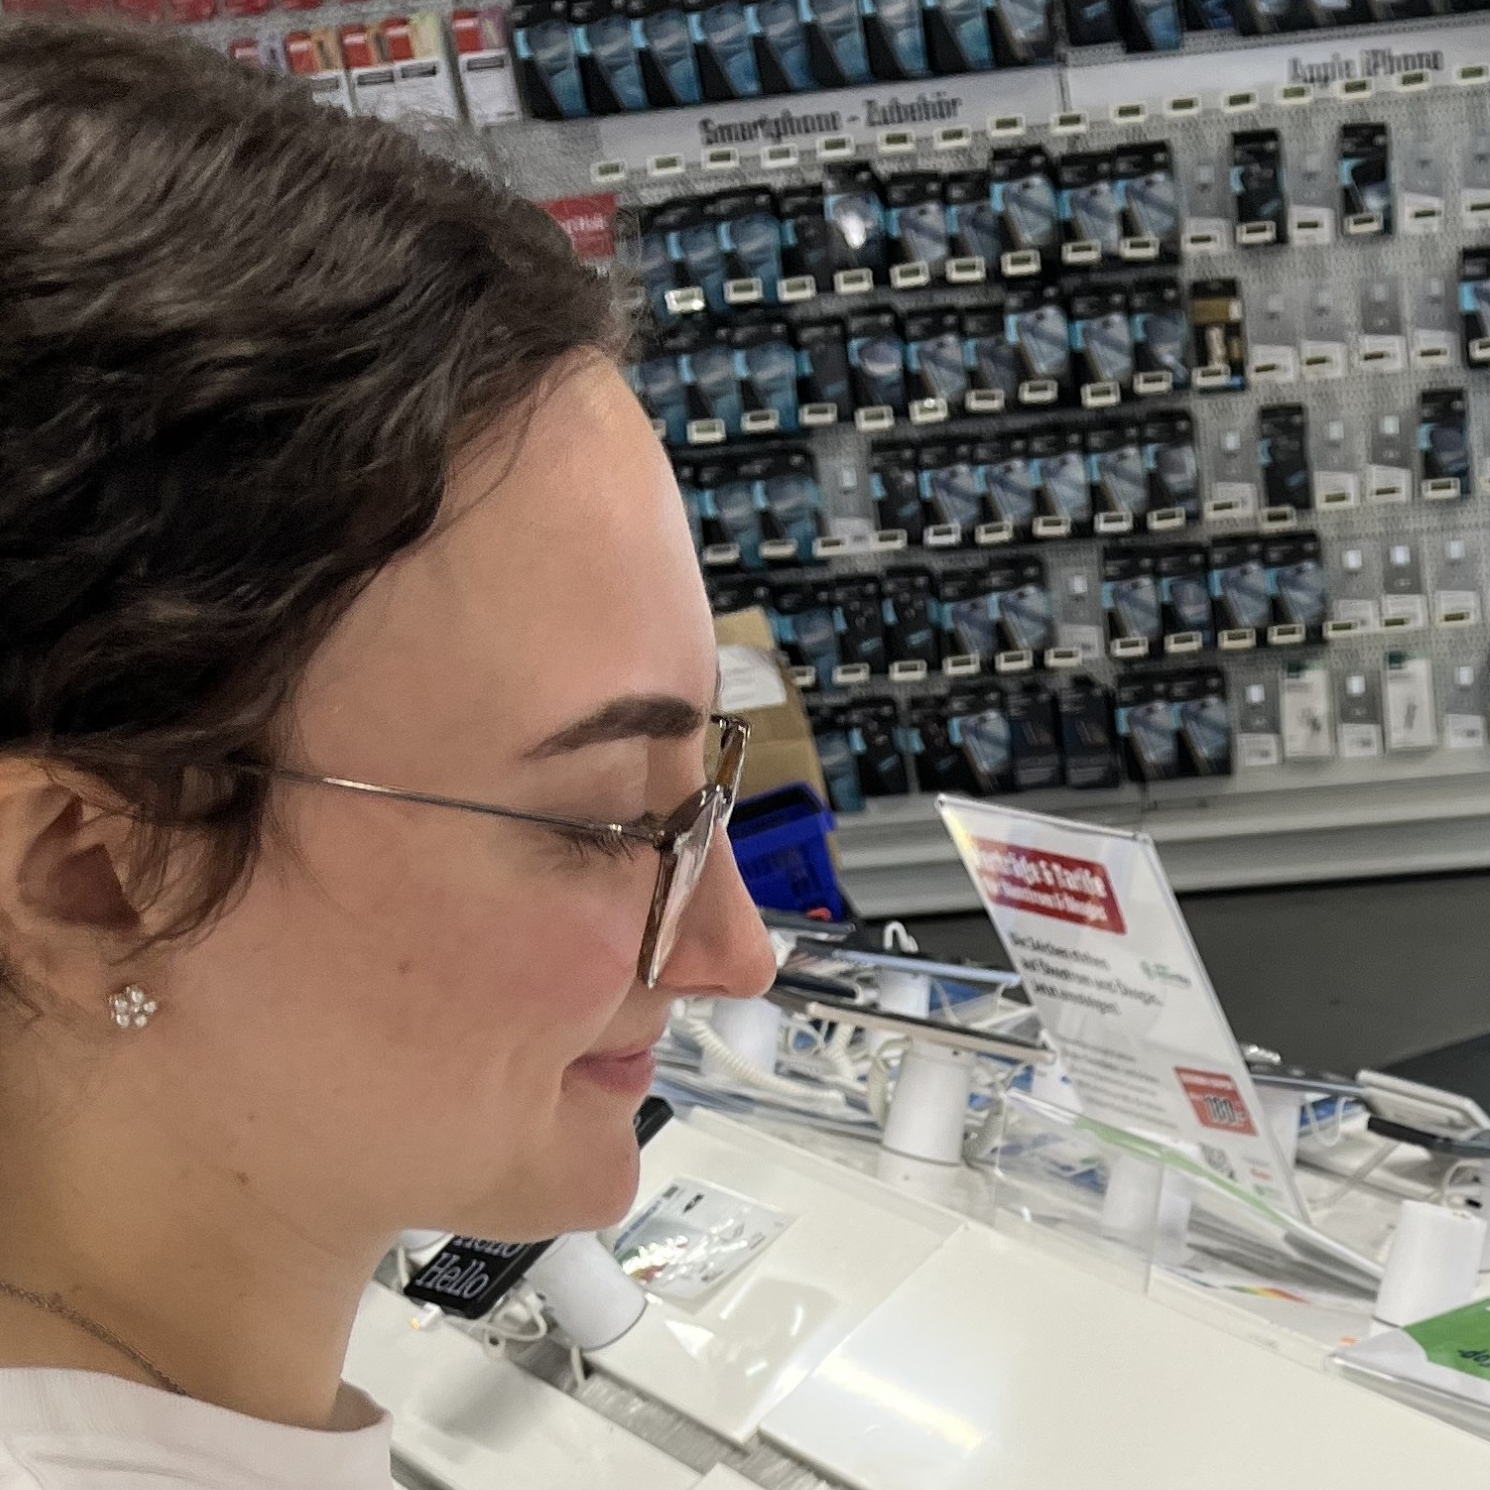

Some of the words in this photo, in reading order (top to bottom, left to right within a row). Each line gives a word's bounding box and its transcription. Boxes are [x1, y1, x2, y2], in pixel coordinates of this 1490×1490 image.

[1360, 49, 1444, 77] iPhone
[700, 107, 843, 145] Smartphone
[864, 91, 964, 127] Zubehör
[415, 1251, 489, 1299] Hello
